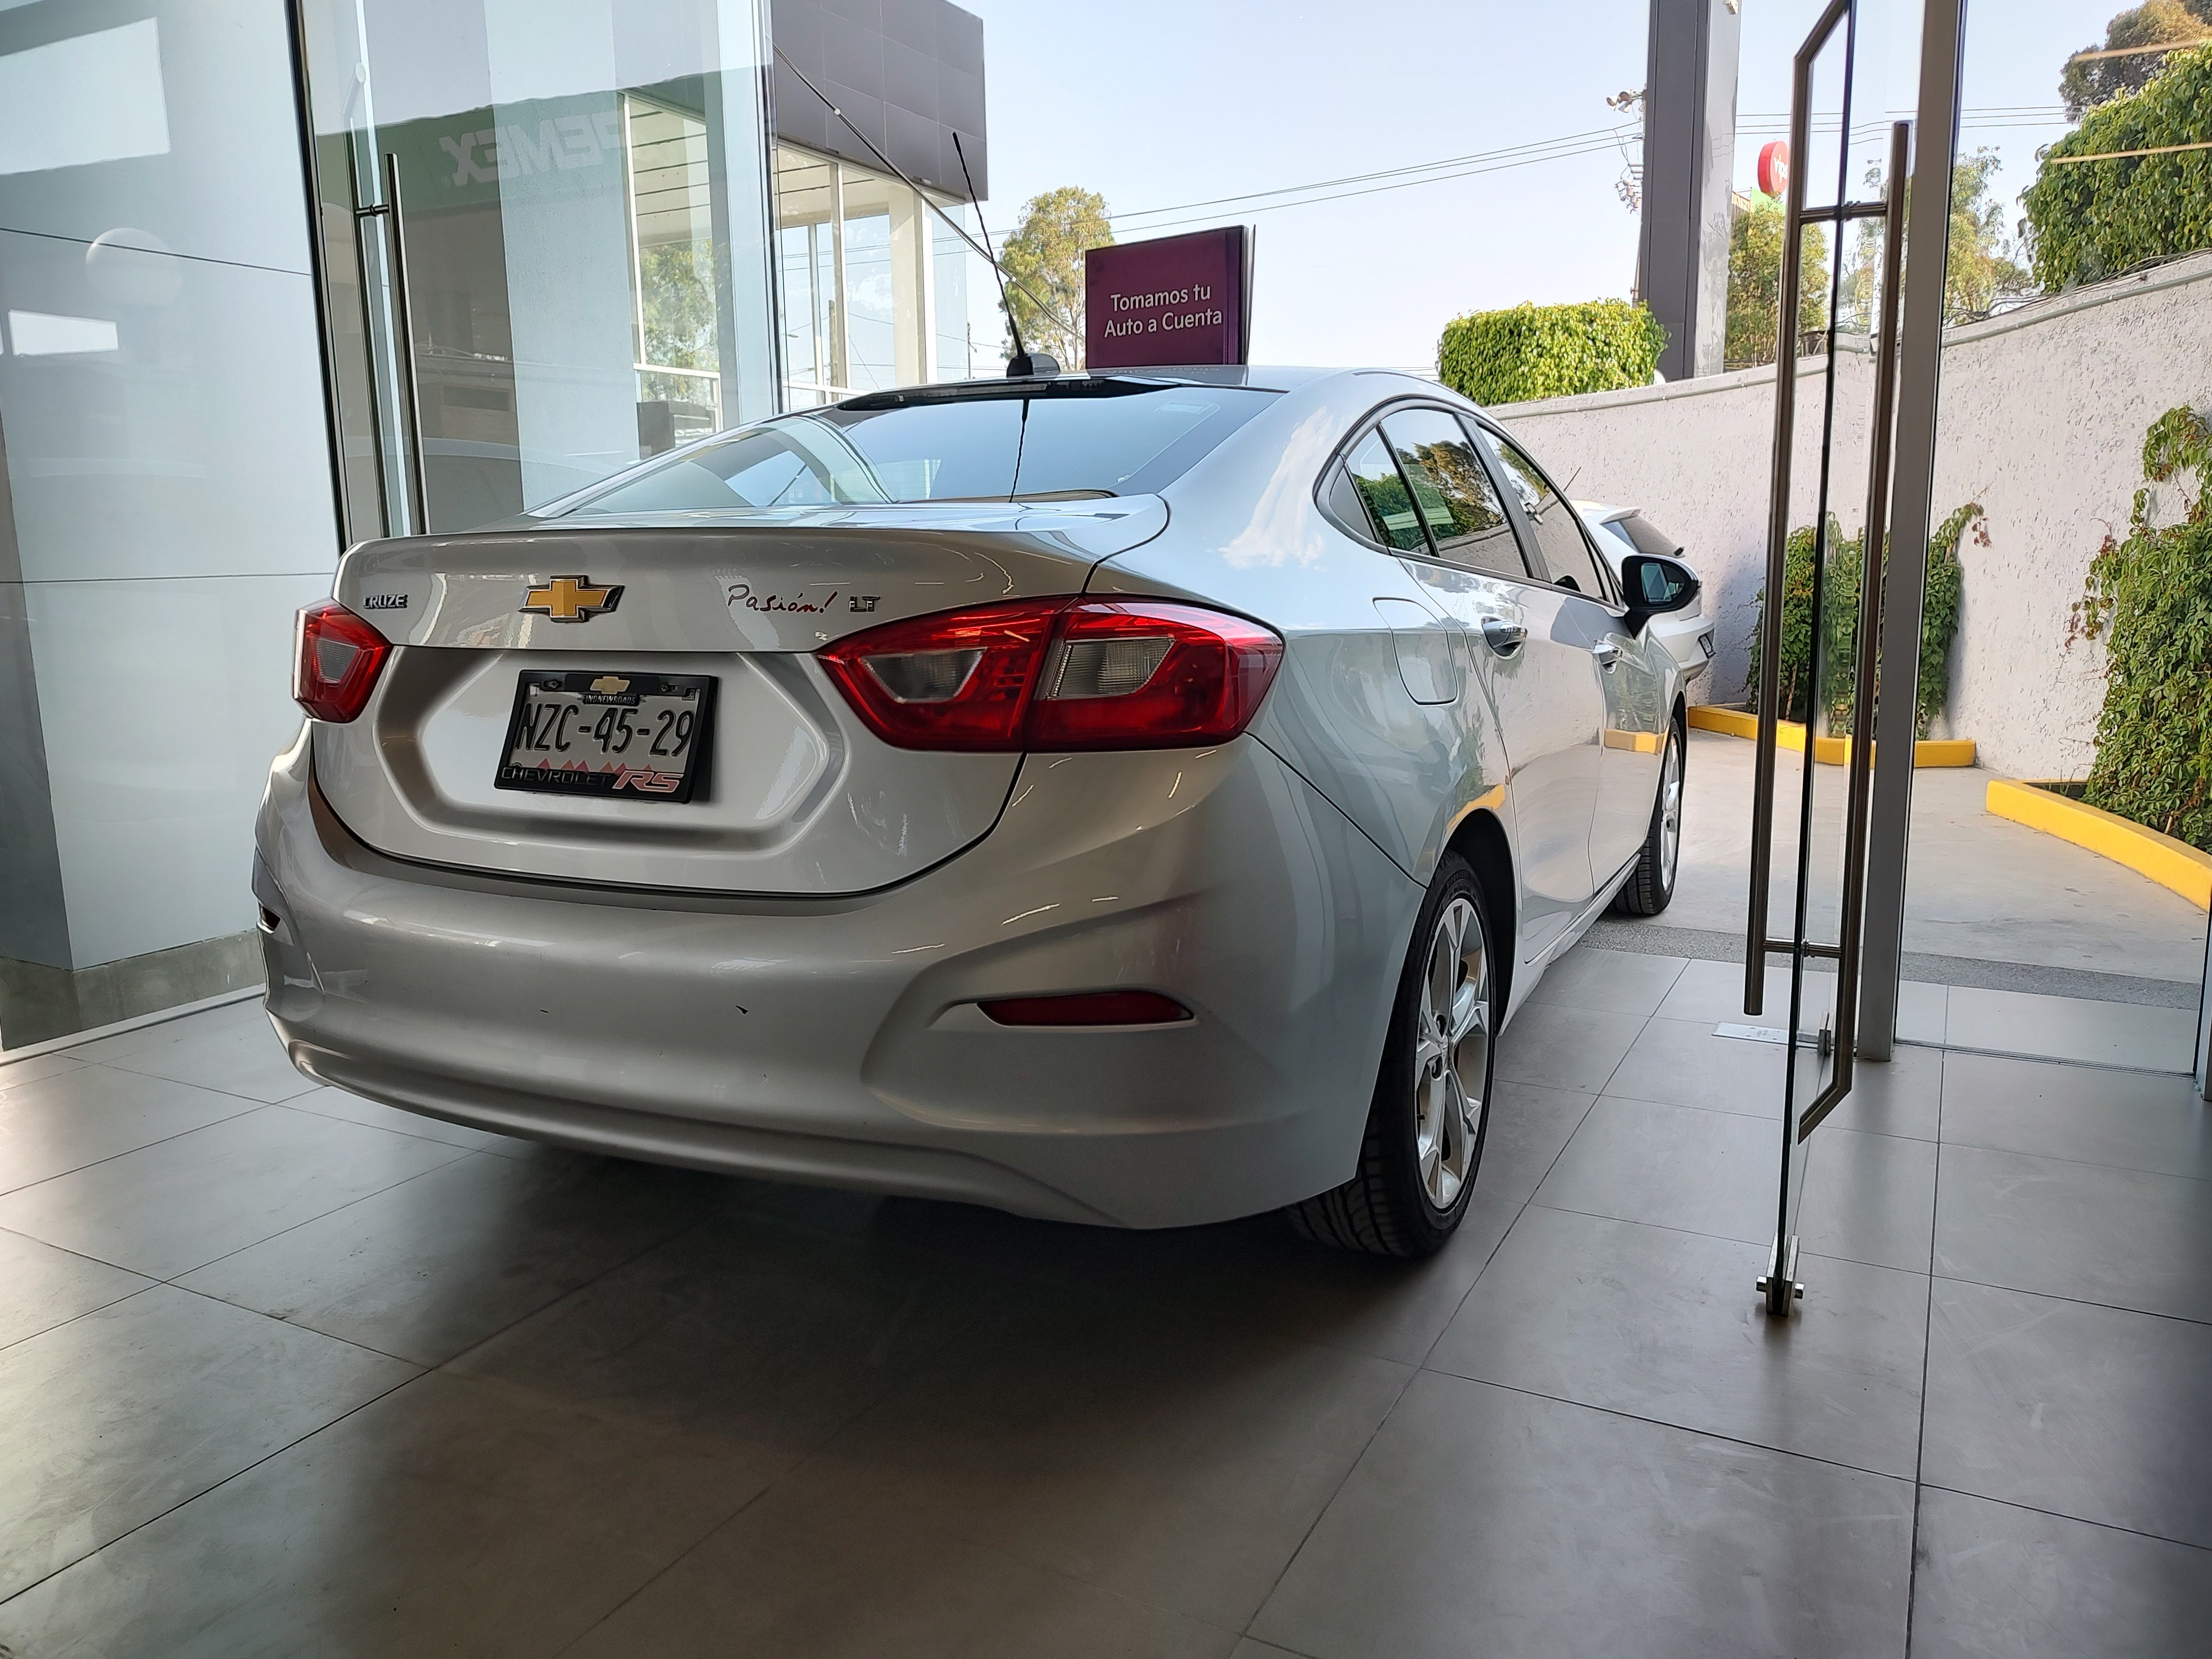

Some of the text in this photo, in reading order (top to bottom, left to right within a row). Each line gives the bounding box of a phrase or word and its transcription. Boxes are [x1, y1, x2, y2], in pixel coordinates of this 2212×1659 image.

[1110, 284, 1211, 312] Tomamos tu
[1104, 308, 1222, 338] Auto a Cuenta
[363, 594, 408, 609] CRUZE
[849, 596, 881, 612] LT
[515, 703, 695, 757] NZC-45-29
[501, 766, 685, 792] CHEVROLET RS
